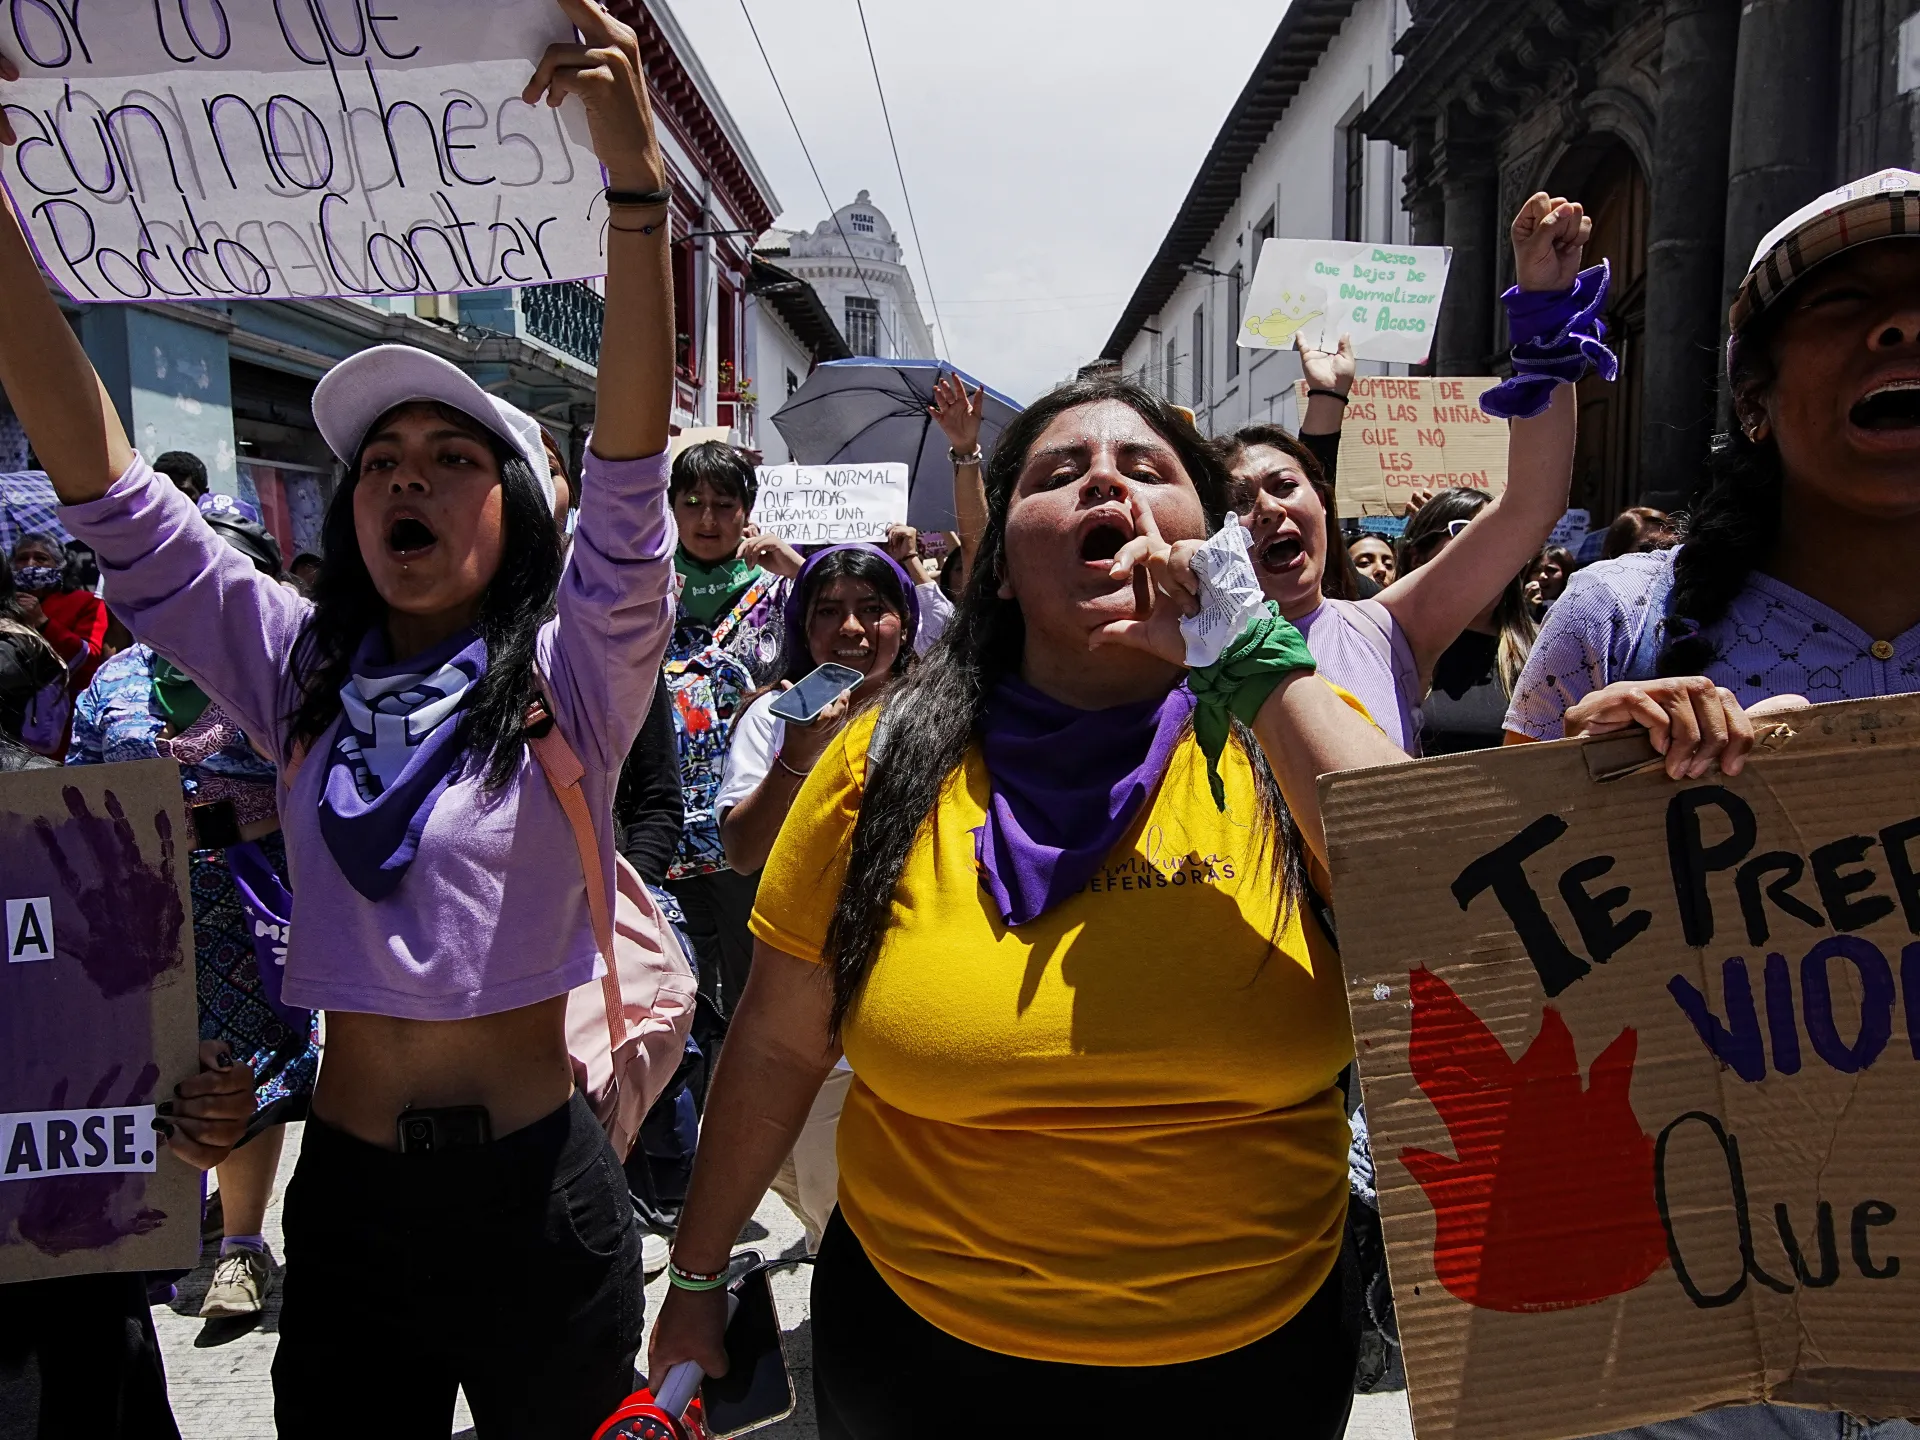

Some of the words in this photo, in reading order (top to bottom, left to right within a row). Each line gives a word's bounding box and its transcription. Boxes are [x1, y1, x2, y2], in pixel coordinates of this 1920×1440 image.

[0, 0, 92, 68] or
[203, 94, 333, 190] no
[1371, 248, 1416, 266] Deseo
[1314, 261, 1341, 277] Que
[1353, 264, 1396, 284] Dejes
[1406, 268, 1428, 283] De
[1339, 283, 1436, 304] Normalizar
[1351, 305, 1368, 324] El
[1440, 381, 1465, 400] DE
[1387, 404, 1418, 422] LAS
[1433, 404, 1491, 424] NIÑAS
[1362, 428, 1399, 446] QUE
[1417, 428, 1446, 447] NO
[1379, 452, 1414, 471] LES
[824, 469, 896, 487] NORMAL
[1385, 470, 1489, 489] CREYERON
[763, 490, 794, 508] QUE
[800, 489, 847, 508] TODAS
[755, 507, 828, 523] TENGAMOS
[835, 506, 864, 520] UNA
[760, 523, 811, 540] ISTORIA
[815, 523, 840, 540] DE
[13, 901, 49, 957] A
[4, 1114, 155, 1175] ARSE.
[1655, 1111, 1900, 1308] Que
